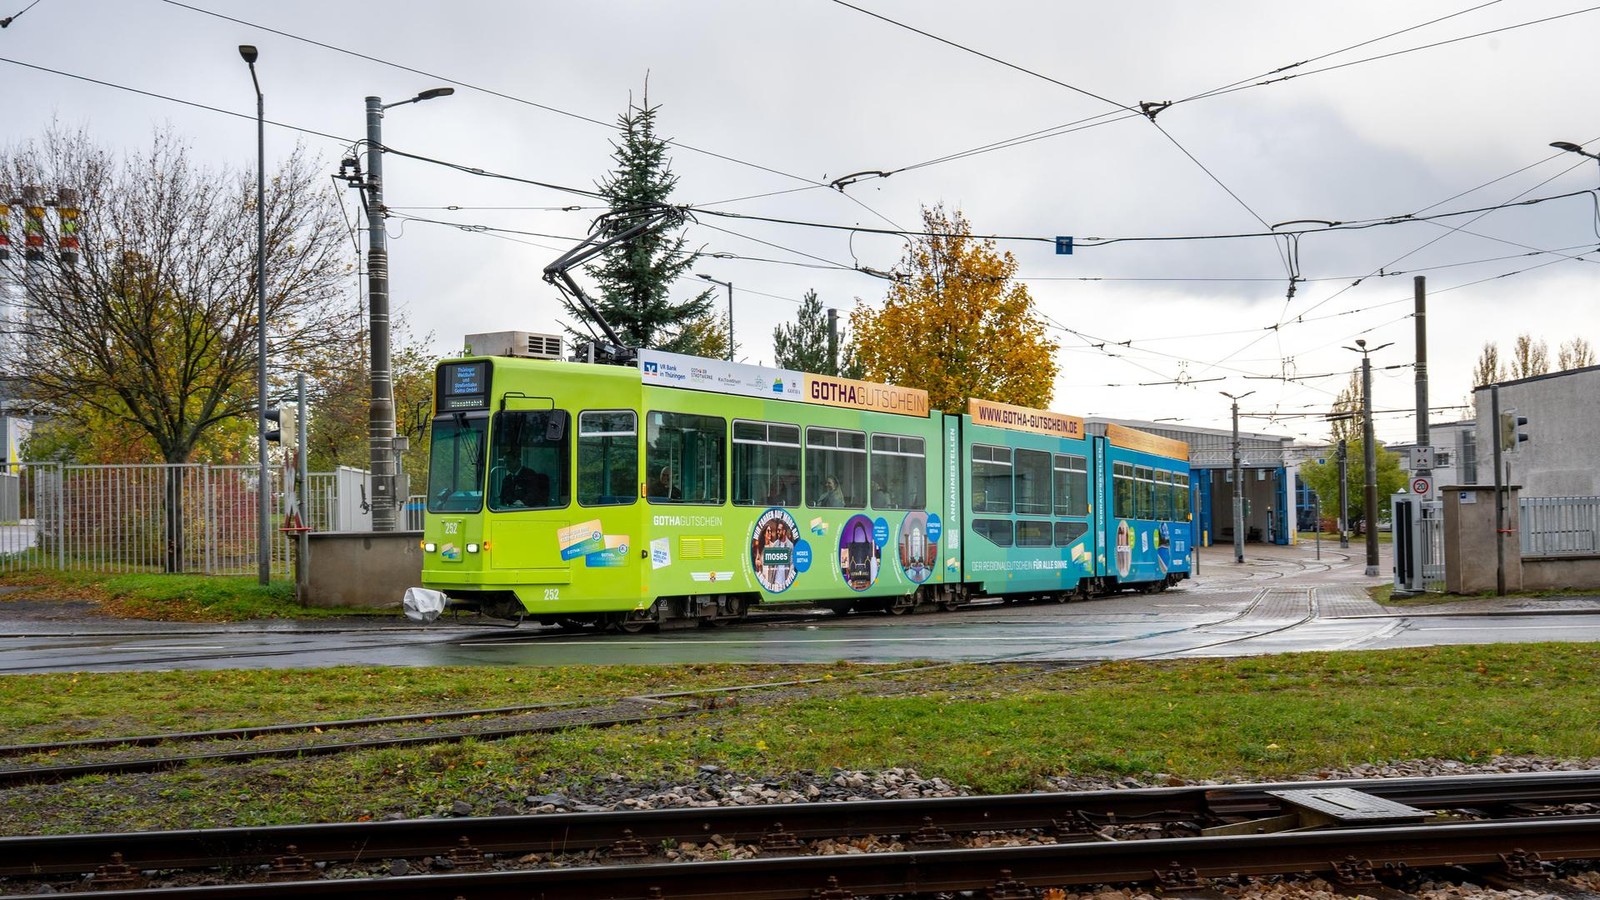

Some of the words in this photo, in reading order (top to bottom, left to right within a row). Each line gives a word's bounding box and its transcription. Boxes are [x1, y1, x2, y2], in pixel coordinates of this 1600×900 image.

[665, 371, 686, 381] Thüringen
[811, 380, 925, 412] GOTHAGUTSCHEIN
[979, 406, 1078, 434] WWW.GOTHA-GUTSCHEIN.DE
[1416, 482, 1426, 491] 20
[653, 515, 723, 526] GOTHAGUTSCHEIN
[445, 522, 458, 535] 252
[765, 553, 788, 561] moses
[971, 561, 983, 571] DER
[1033, 558, 1043, 570] FÜR
[1043, 560, 1054, 570] ALLE
[1054, 560, 1067, 570] SINNE
[544, 588, 559, 600] 252
[660, 599, 668, 607] 20
